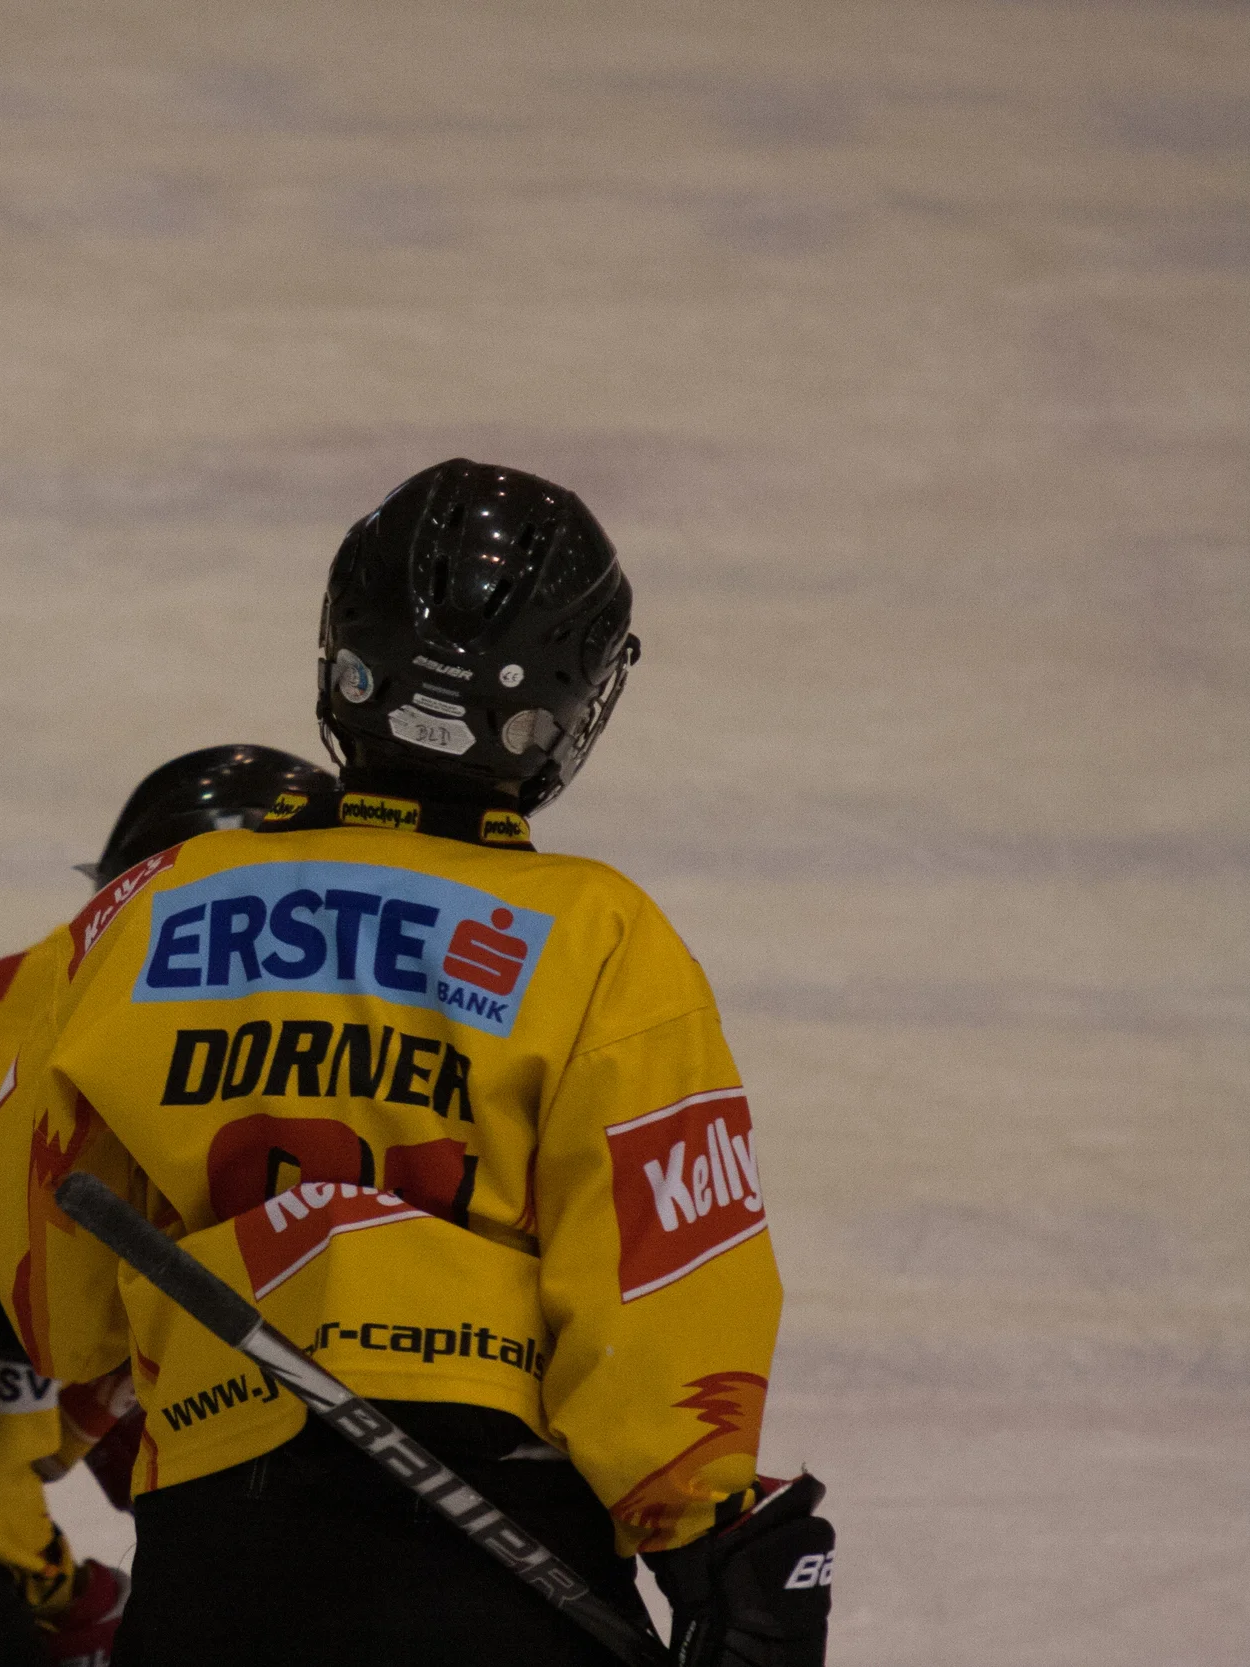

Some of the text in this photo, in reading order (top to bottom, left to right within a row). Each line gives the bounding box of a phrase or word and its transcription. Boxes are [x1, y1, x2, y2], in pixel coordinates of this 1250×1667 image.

[342, 799, 417, 828] prohockey.at
[146, 888, 440, 994] ERSTE
[437, 980, 510, 1024] BANK
[160, 1019, 475, 1124] DORNER
